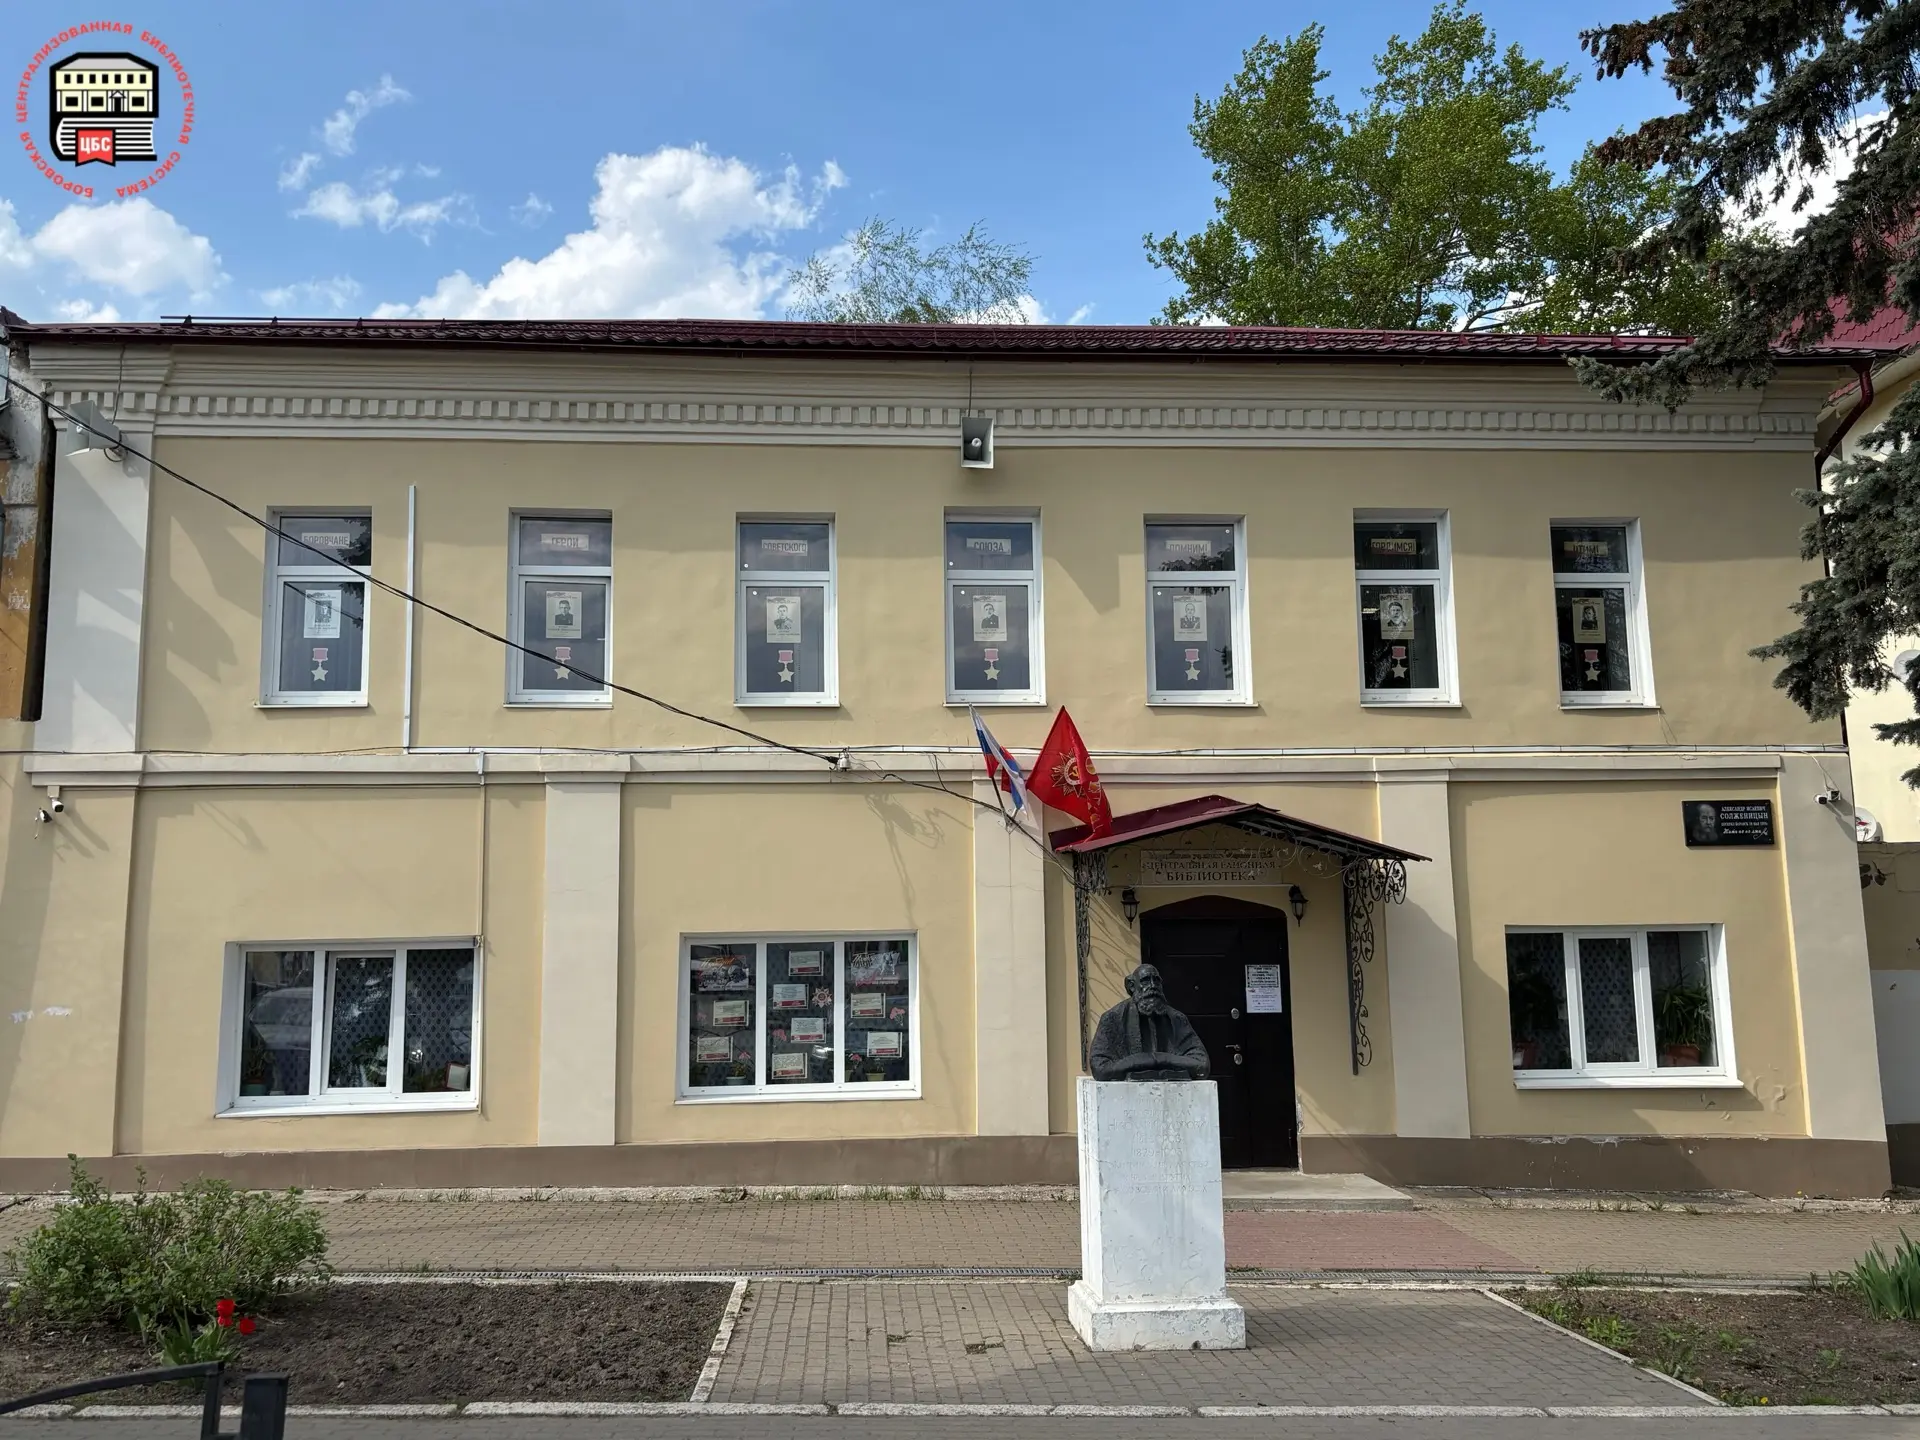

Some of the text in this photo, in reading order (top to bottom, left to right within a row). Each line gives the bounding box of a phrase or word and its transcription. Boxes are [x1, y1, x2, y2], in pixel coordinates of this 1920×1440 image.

[303, 535, 348, 546] БОРОВЧАНЕ
[763, 541, 807, 551] СОВЕТСКОГО
[973, 541, 1004, 551] СОЮЗА
